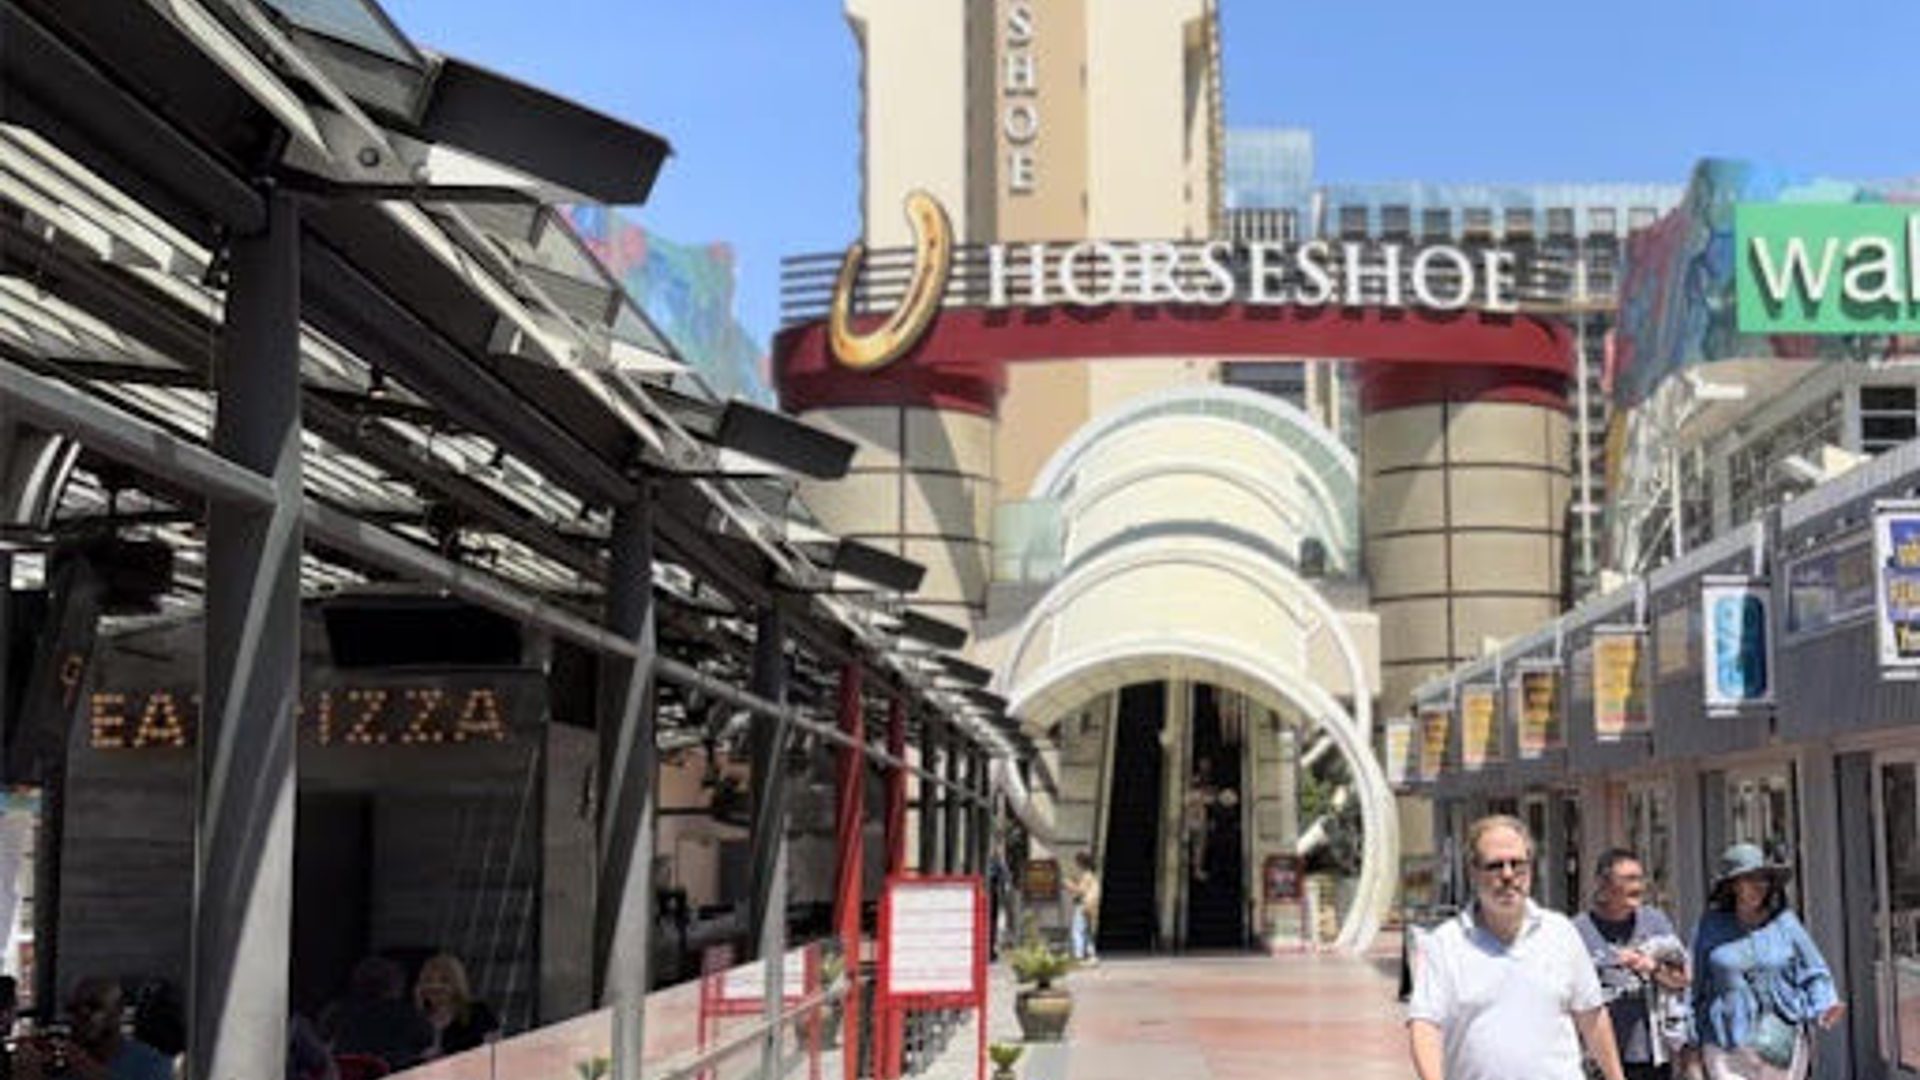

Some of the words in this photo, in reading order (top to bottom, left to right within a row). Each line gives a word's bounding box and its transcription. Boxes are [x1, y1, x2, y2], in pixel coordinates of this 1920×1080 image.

[988, 240, 1519, 313] HORSESHOE
[90, 692, 203, 749] EA
[295, 688, 503, 745] IZZA
